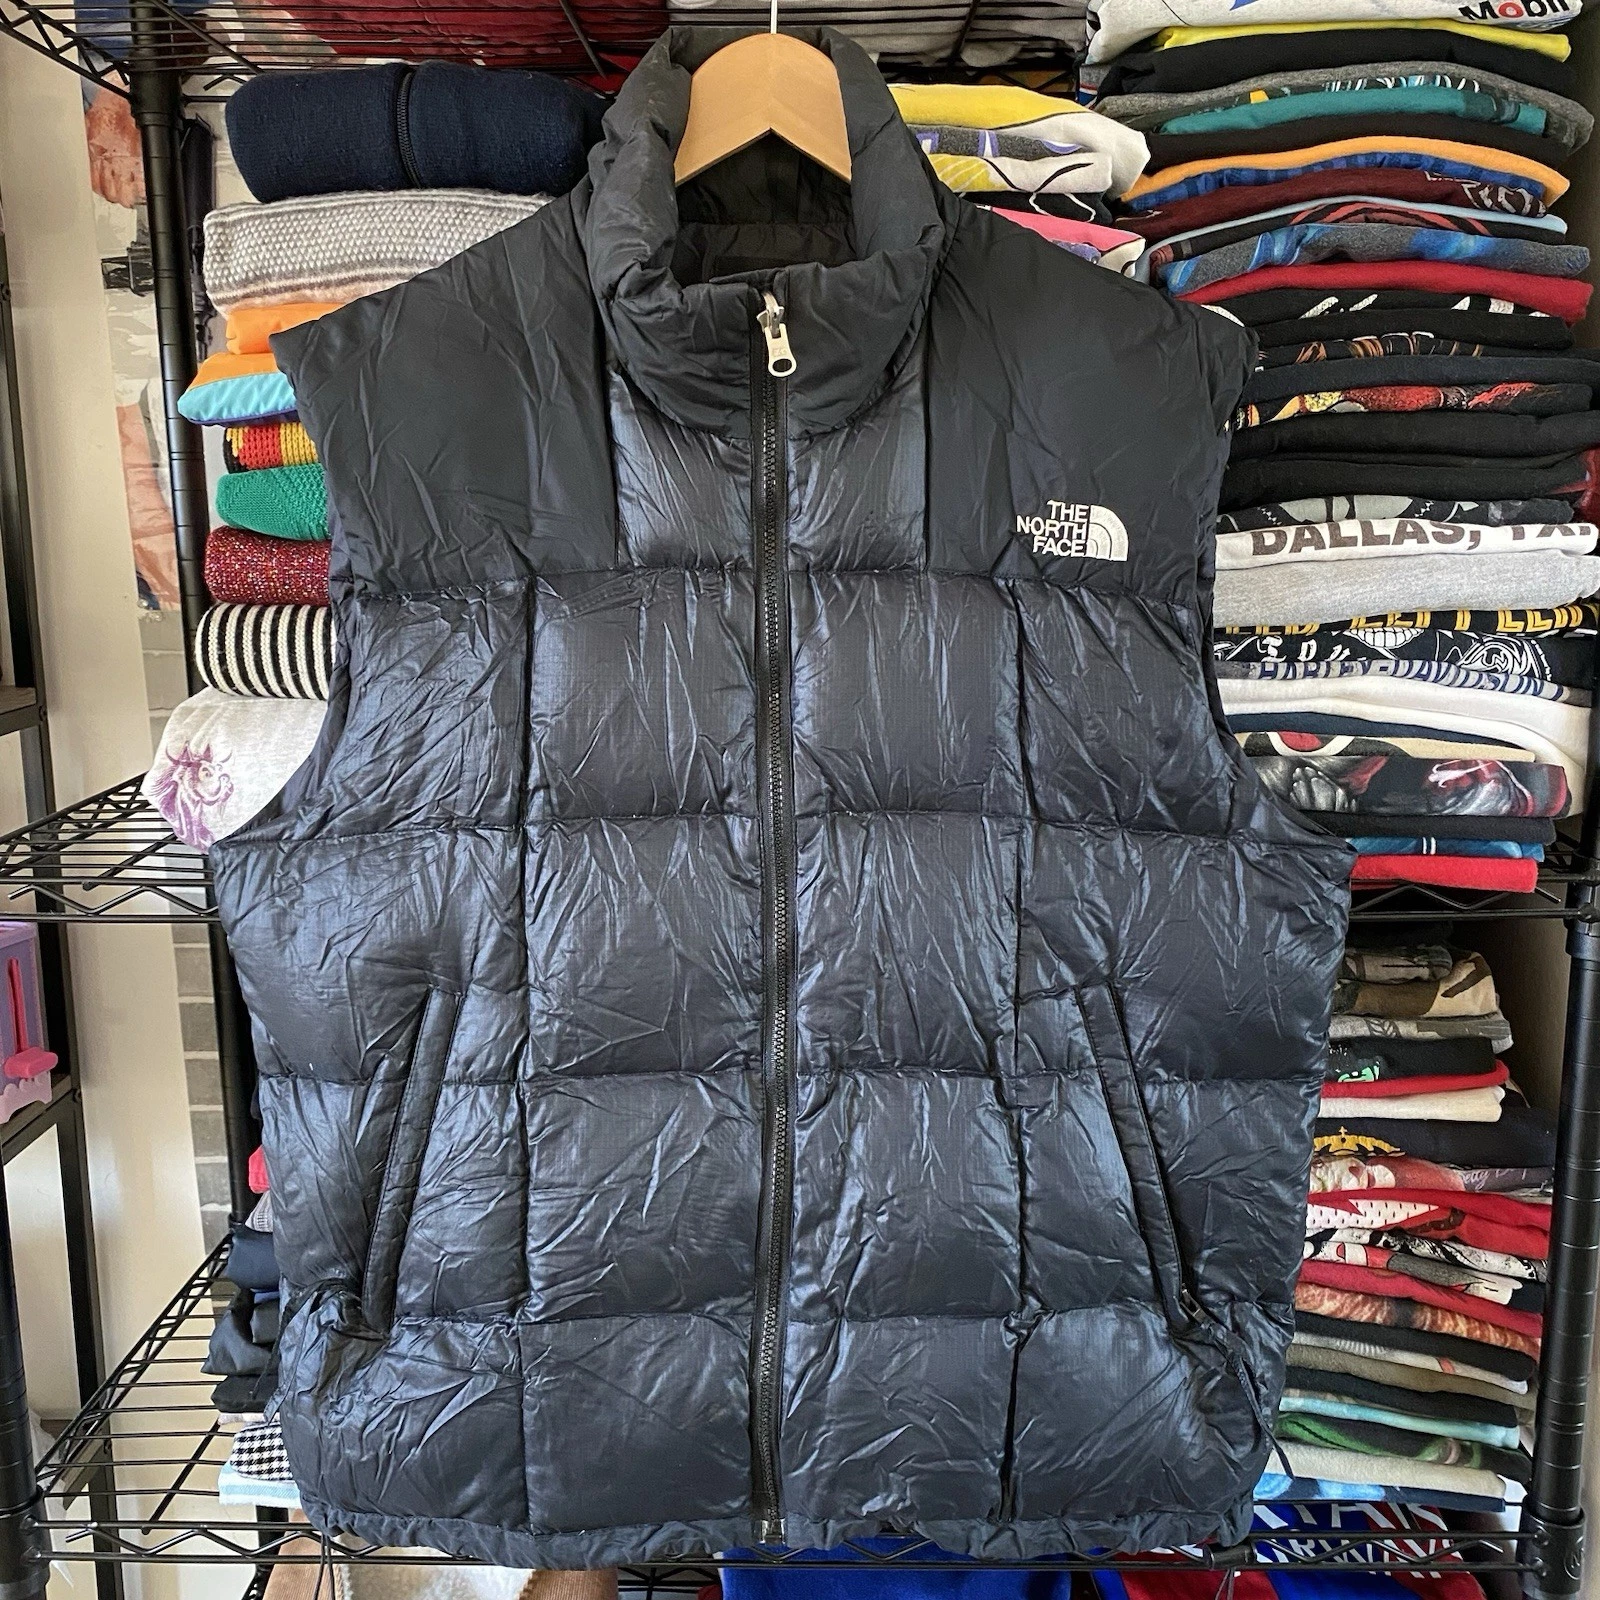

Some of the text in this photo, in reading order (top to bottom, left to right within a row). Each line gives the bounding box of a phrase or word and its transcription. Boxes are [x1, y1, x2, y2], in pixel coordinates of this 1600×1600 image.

[1458, 0, 1570, 20] Mobil
[1047, 499, 1090, 522] THE
[1016, 515, 1088, 540] NORTH
[1252, 519, 1481, 556] DALLAS,
[1032, 535, 1086, 557] FACE
[1461, 1169, 1490, 1190] etty
